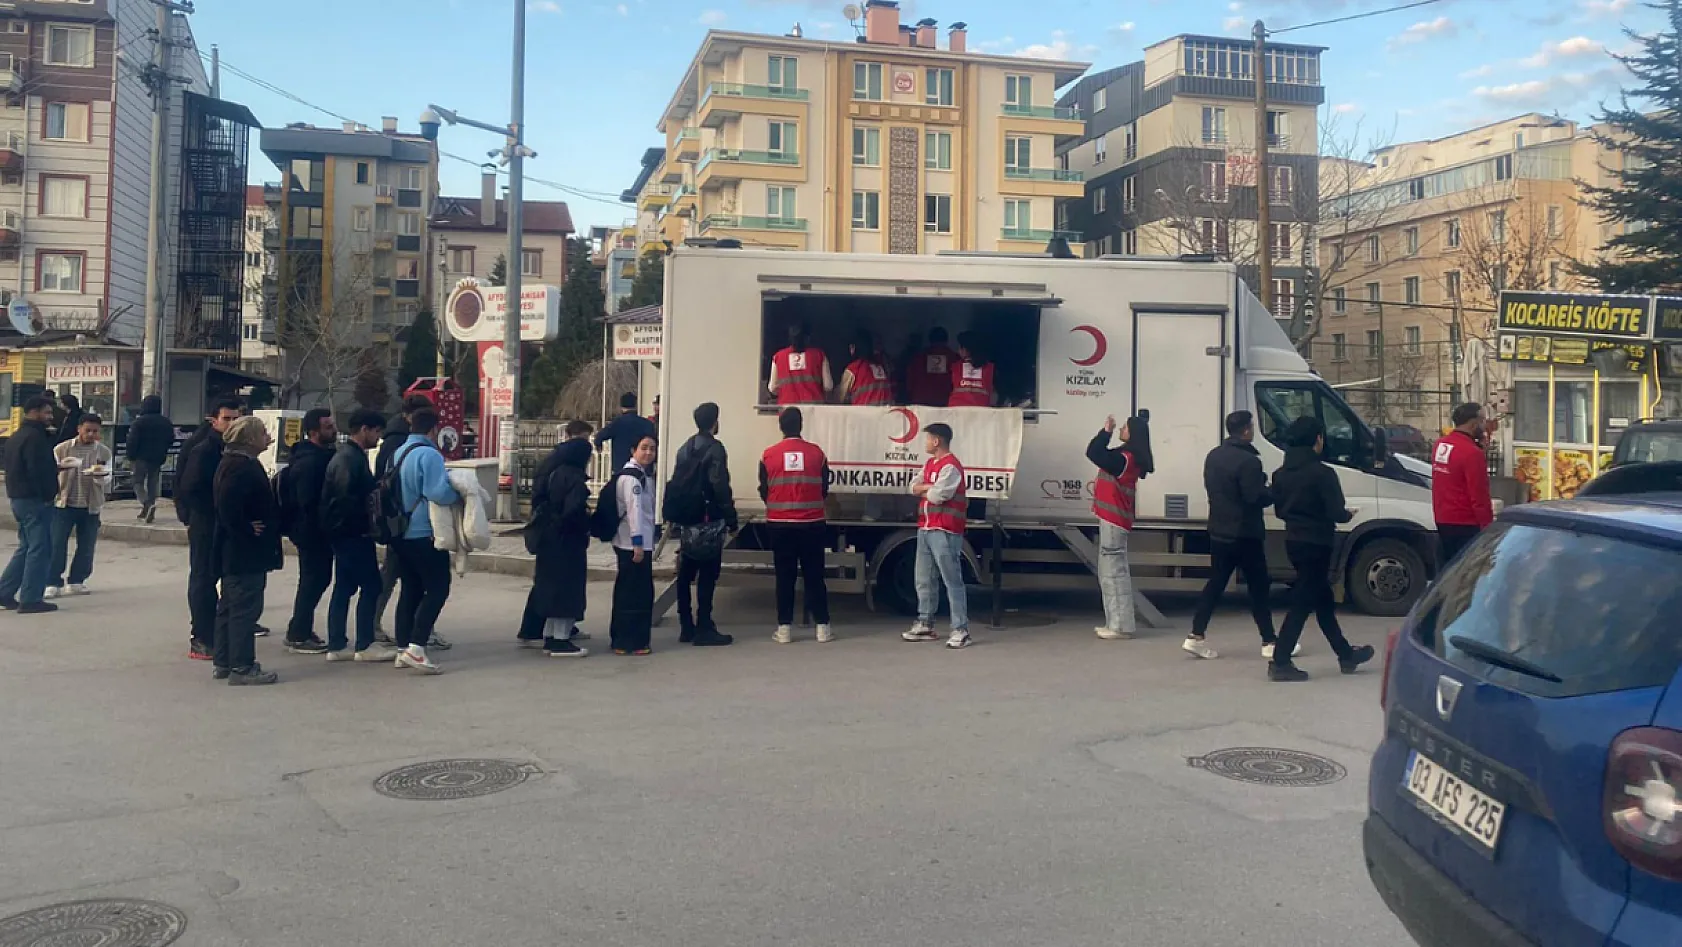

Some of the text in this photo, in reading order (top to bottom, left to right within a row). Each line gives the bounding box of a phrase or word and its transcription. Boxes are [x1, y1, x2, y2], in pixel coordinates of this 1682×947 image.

[1505, 299, 1643, 332] KOCAREİS KÖFTE
[1066, 376, 1106, 386] KIZILAY
[885, 452, 919, 461] KIZILAY
[1062, 480, 1081, 489] 168
[1412, 759, 1431, 794] 03
[1432, 773, 1462, 815] AFS
[1464, 793, 1500, 840] 225
